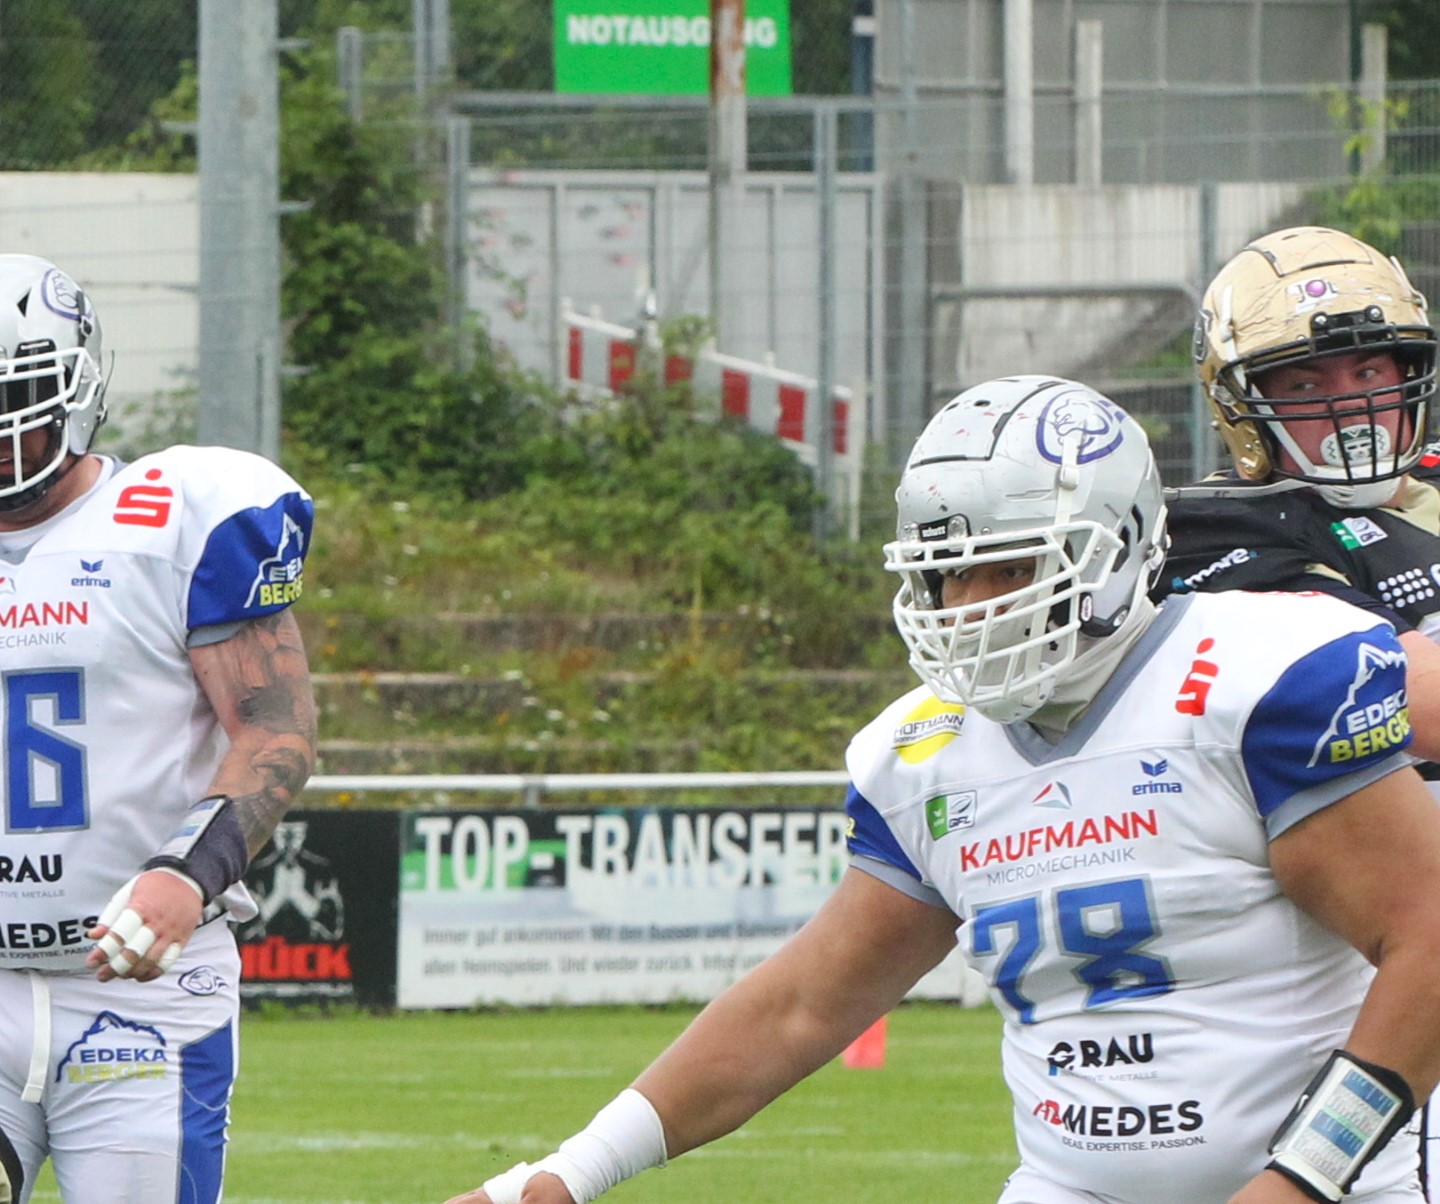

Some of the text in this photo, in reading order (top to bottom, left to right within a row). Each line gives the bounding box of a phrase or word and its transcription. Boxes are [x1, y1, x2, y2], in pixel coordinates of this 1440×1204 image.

[567, 15, 777, 47] NOTAUSGNG
[71, 576, 111, 588] erima
[1346, 690, 1407, 734] EDEK
[895, 714, 964, 737] HOFFMANN
[1132, 781, 1182, 796] erima
[949, 816, 972, 828] GFL
[959, 810, 1158, 872] KAUFMANN
[987, 848, 1136, 887] MICROMECHANIK
[971, 874, 1177, 1026] 78
[80, 1047, 167, 1063] EDEKA
[67, 1063, 167, 1084] BERGER
